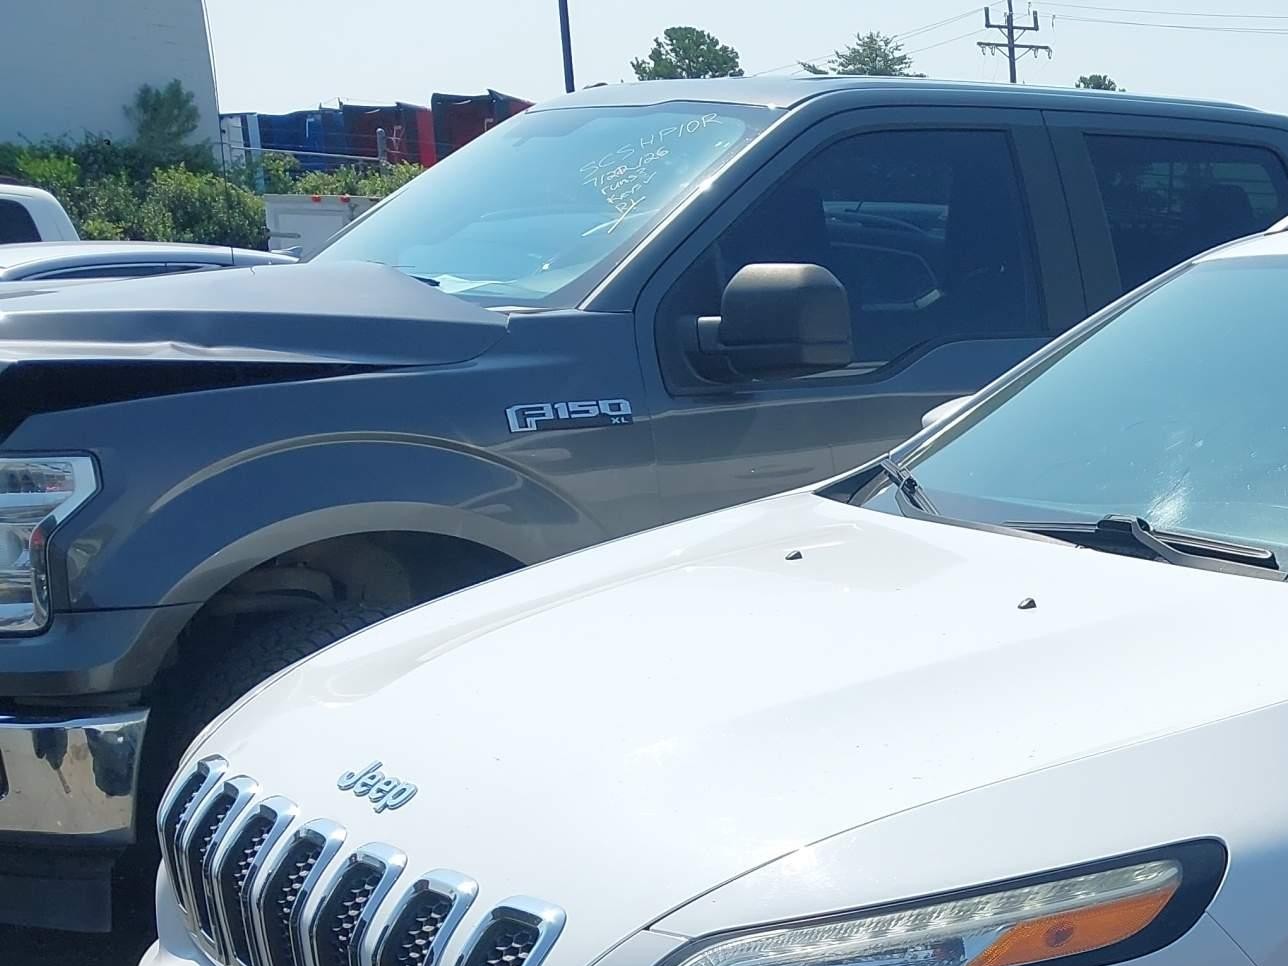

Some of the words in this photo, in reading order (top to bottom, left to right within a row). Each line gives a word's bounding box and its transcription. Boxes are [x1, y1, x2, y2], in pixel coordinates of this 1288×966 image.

[505, 398, 632, 433] F150
[611, 416, 629, 424] XL
[337, 759, 418, 814] Jeep
